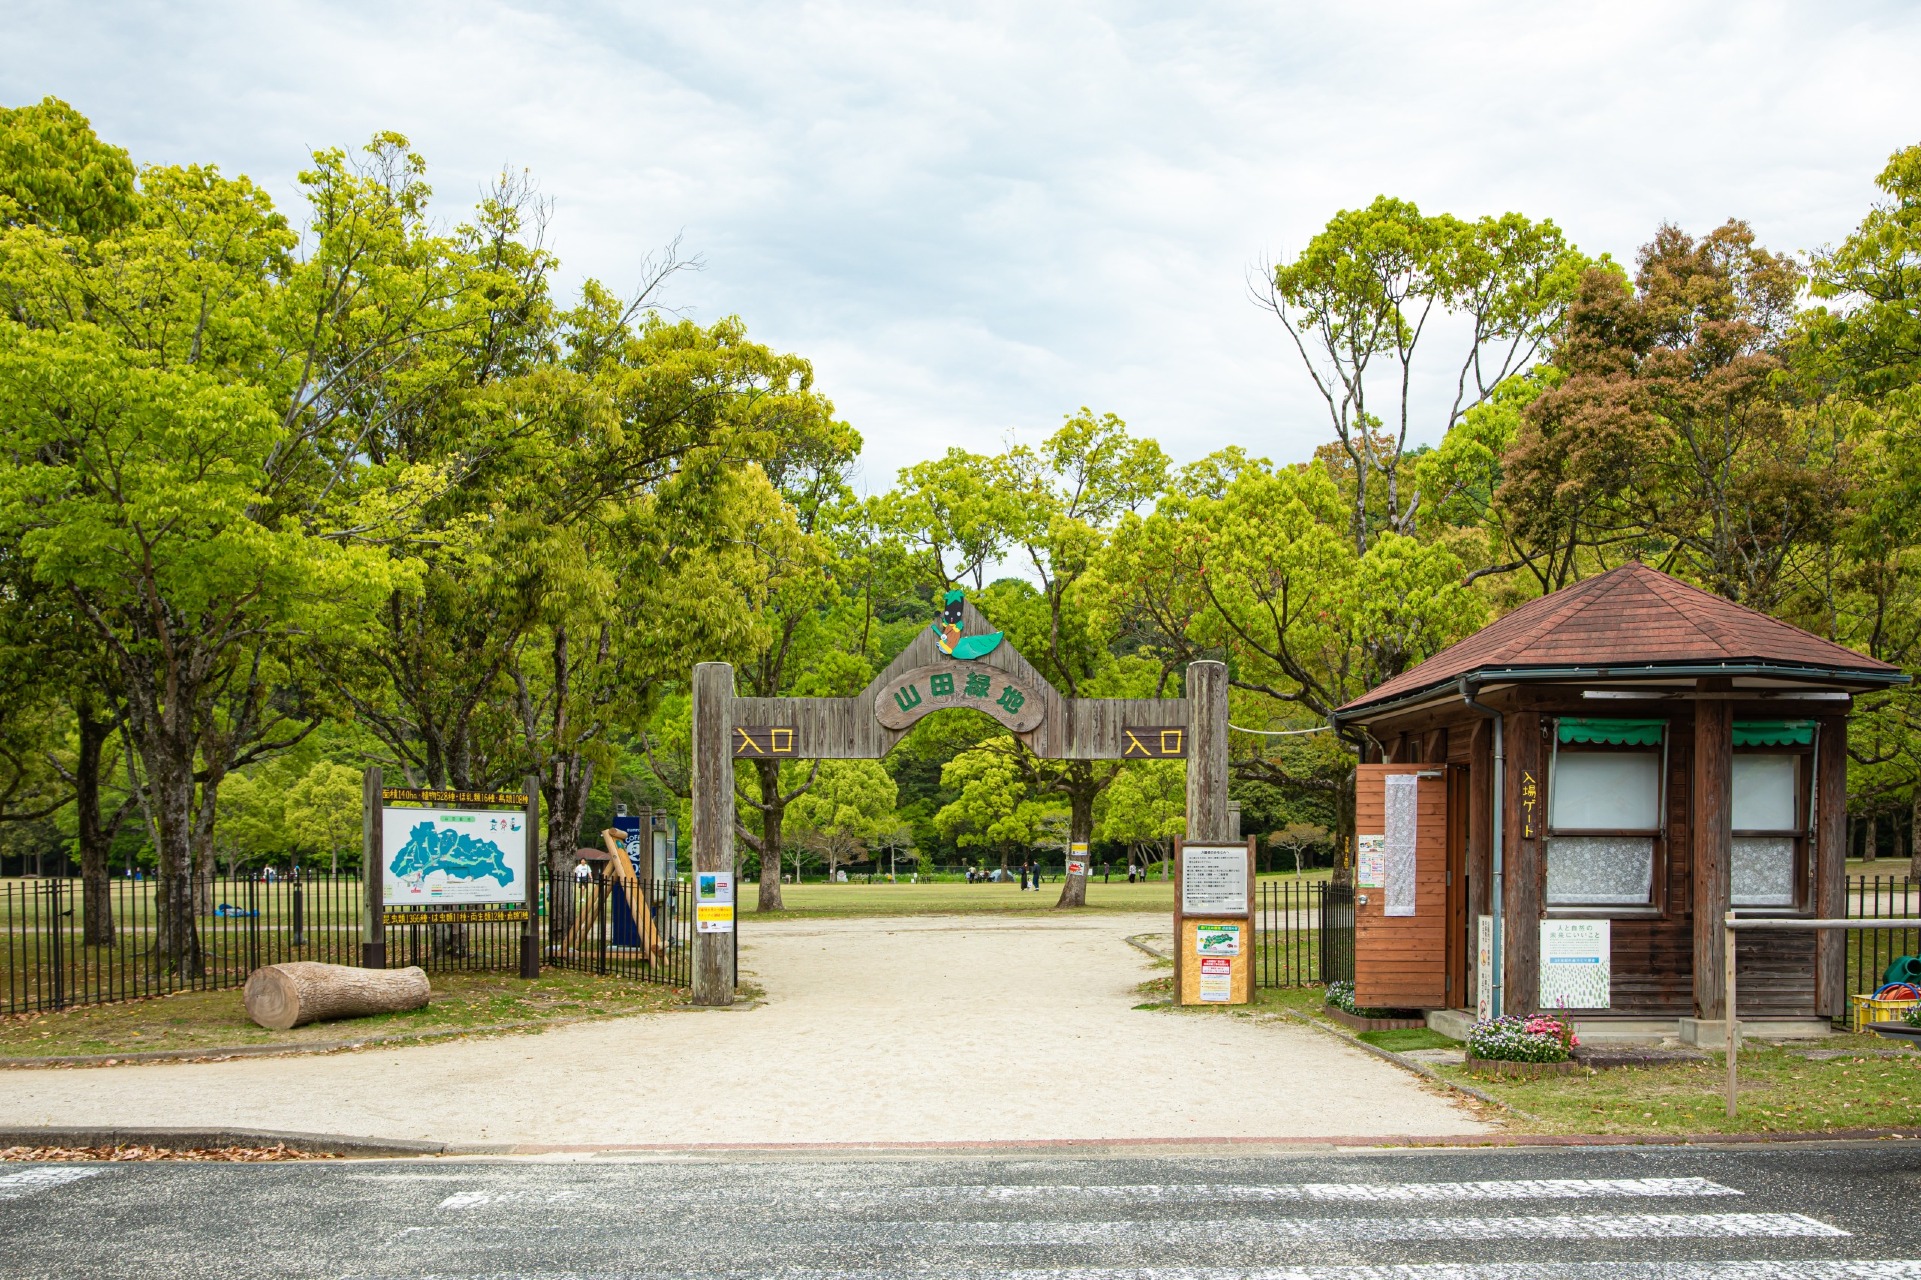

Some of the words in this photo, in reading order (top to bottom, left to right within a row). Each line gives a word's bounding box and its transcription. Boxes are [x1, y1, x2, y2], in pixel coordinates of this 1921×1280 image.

[893, 672, 1025, 715] 山田緑地
[736, 727, 793, 754] 入口
[1125, 729, 1182, 756] 入口
[1522, 771, 1536, 838] 入場ゲート
